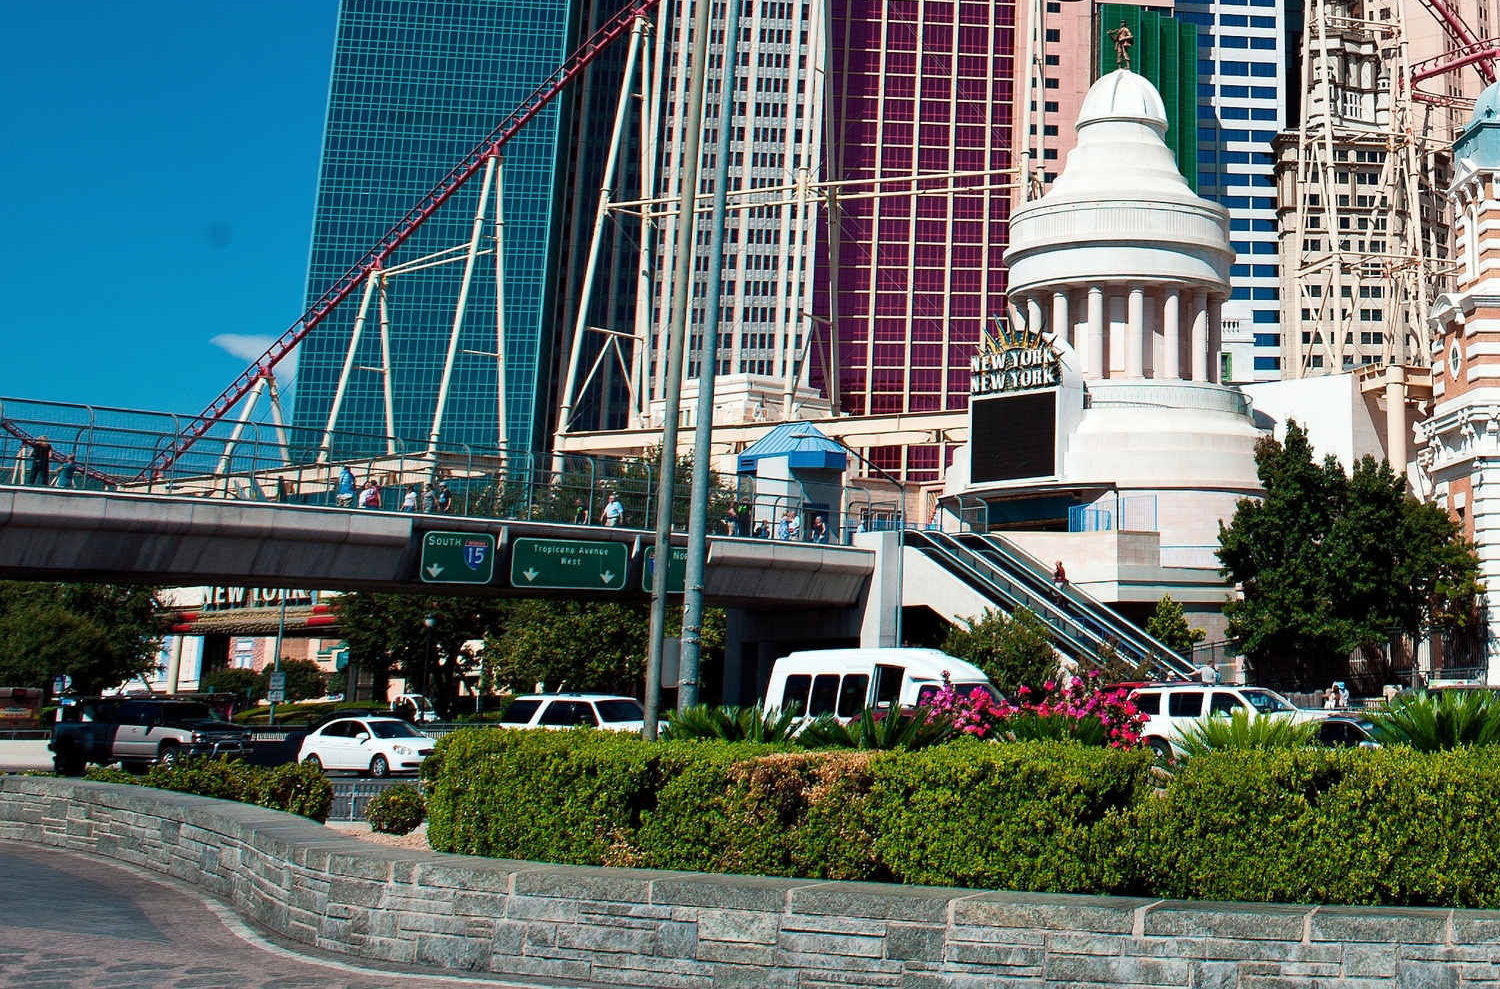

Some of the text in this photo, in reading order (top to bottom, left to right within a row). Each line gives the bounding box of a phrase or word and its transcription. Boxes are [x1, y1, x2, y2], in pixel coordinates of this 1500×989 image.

[971, 349, 1055, 372] NEW YORK
[971, 368, 1055, 392] NEW YORK
[428, 536, 462, 547] SOUTH
[533, 544, 609, 556] Tropicana Avenue
[468, 547, 485, 564] 15
[560, 557, 581, 566] West
[202, 586, 246, 604] NEW
